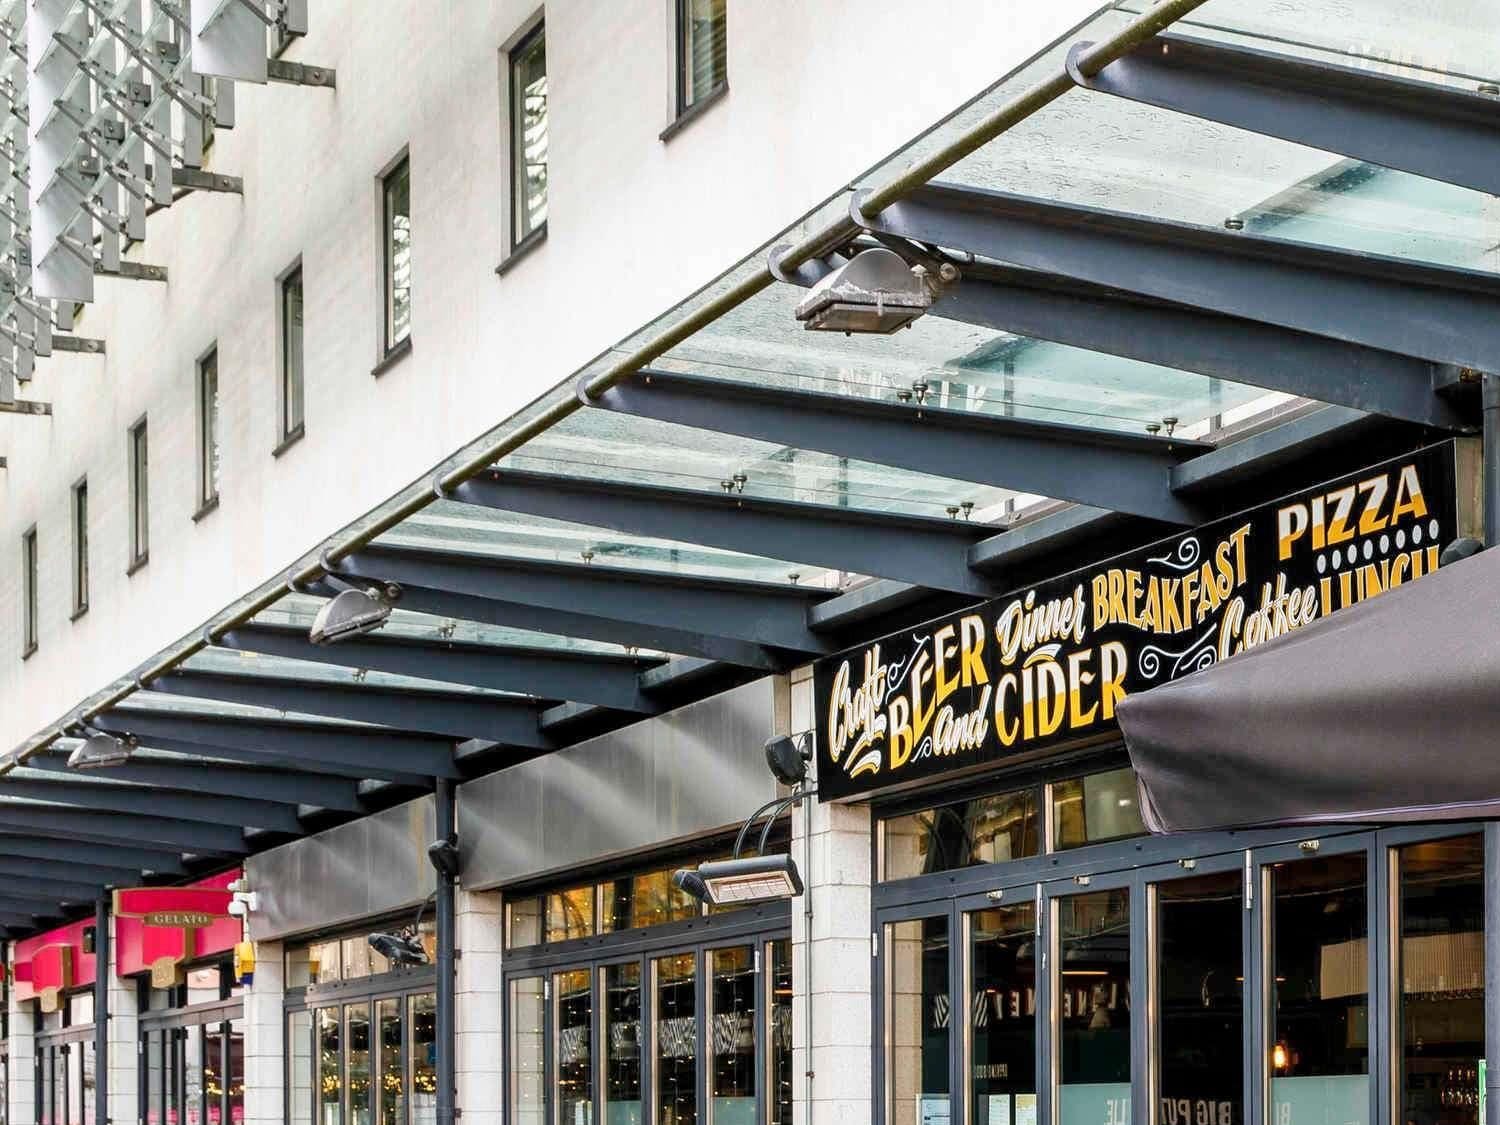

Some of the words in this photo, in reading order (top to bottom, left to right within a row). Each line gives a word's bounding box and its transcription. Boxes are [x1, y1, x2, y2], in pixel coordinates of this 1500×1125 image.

[1277, 464, 1428, 561] PIZZA
[996, 584, 1087, 665] Dinner
[1092, 523, 1252, 634] BREAKFAST
[1219, 572, 1318, 661] Coffee
[828, 643, 888, 763] Craft
[888, 613, 989, 770] BEER
[933, 684, 991, 756] and
[995, 641, 1128, 746] CIDER
[154, 914, 208, 924] GELATO
